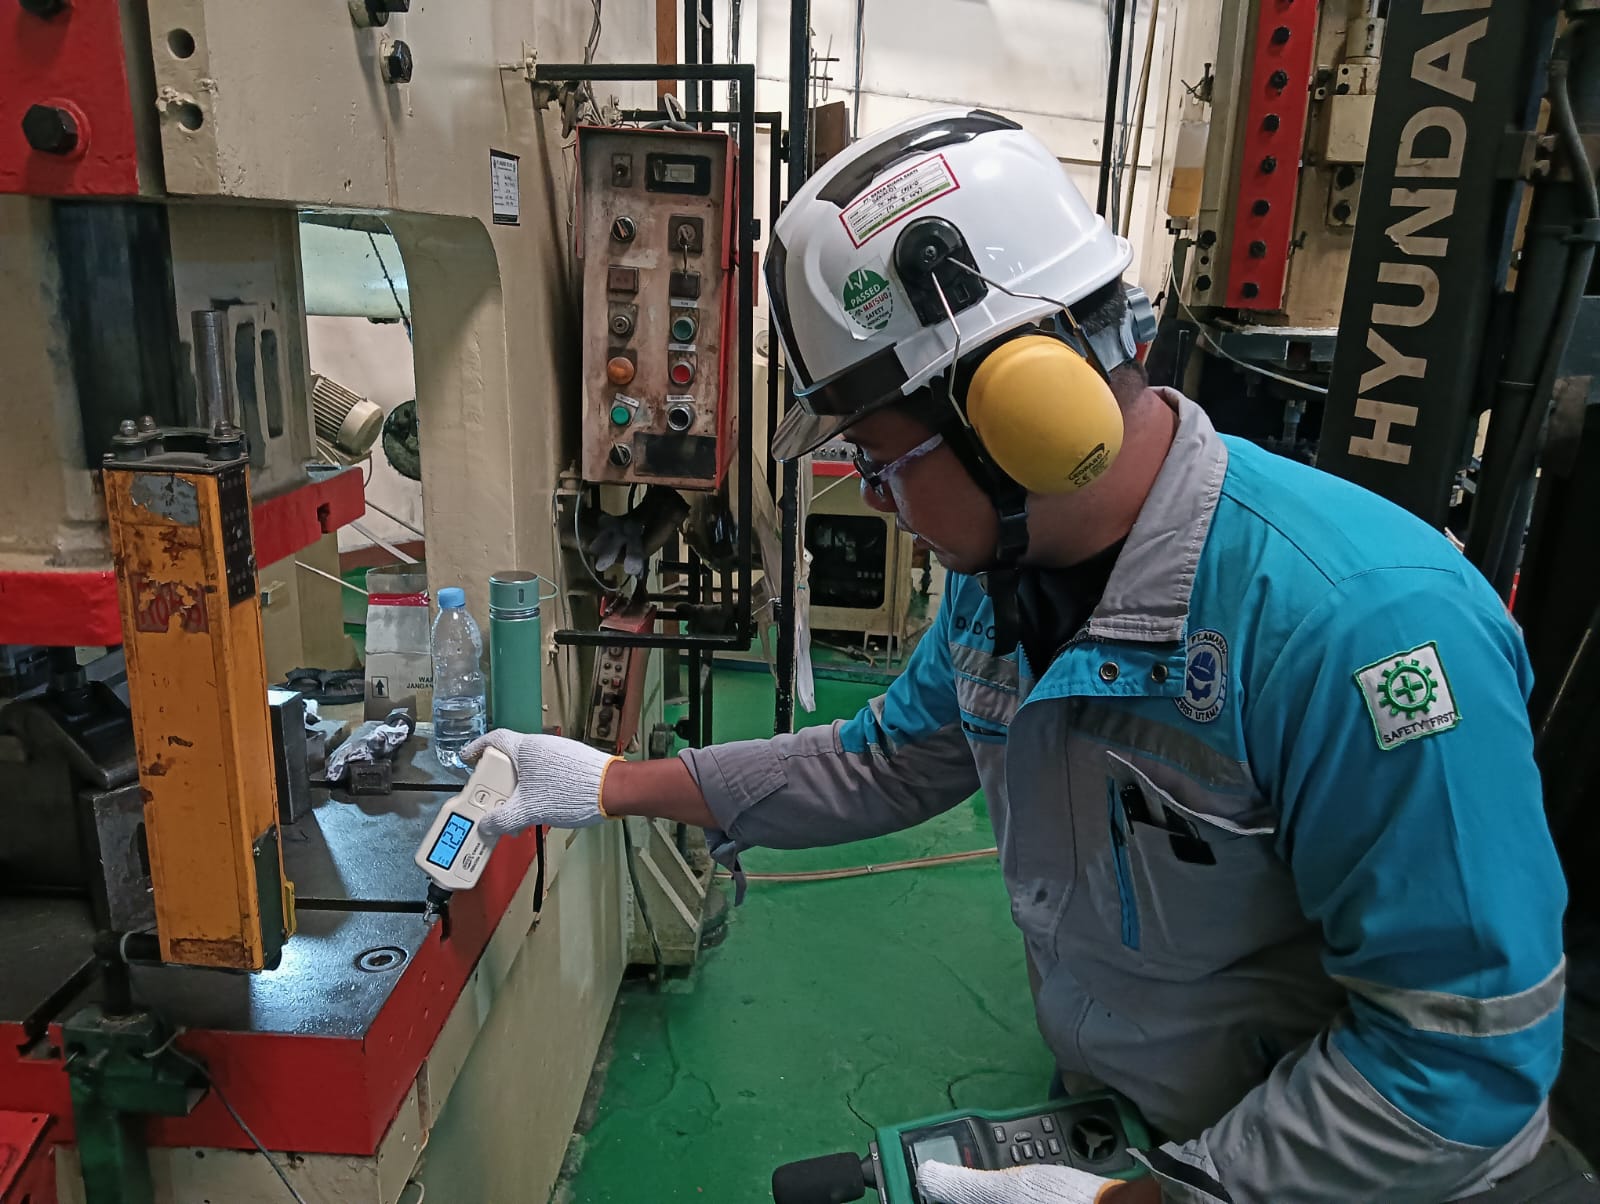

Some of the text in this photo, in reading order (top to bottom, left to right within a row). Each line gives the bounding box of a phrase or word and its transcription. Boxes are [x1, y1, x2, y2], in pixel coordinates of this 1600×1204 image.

[850, 284, 881, 307] PASSED
[863, 292, 889, 312] MATSUO
[865, 305, 884, 320] SAFETY
[1383, 720, 1429, 743] SAFETY
[440, 822, 466, 850] 12.3
